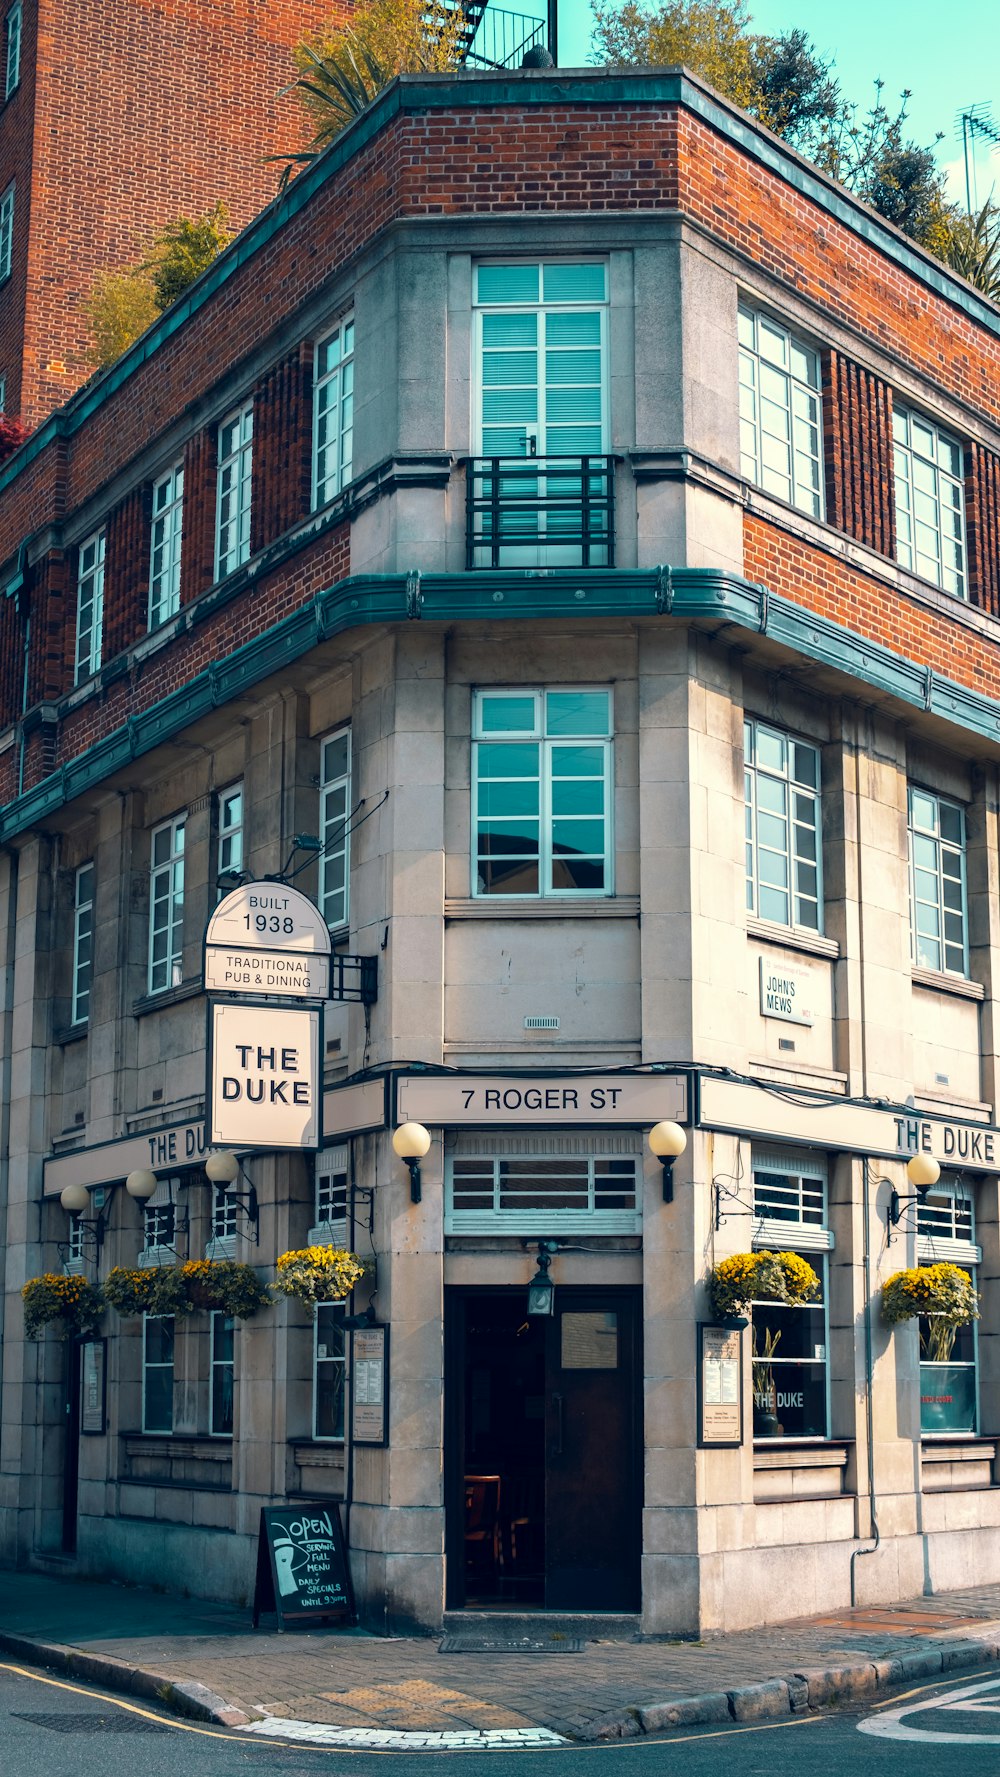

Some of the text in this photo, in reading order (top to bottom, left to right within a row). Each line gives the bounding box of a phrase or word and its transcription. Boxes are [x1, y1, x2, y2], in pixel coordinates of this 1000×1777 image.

[249, 896, 290, 910] BUILT
[243, 913, 294, 934] 1938
[226, 956, 310, 973] TRADITIONAL
[225, 972, 311, 988] PUB & DINING
[766, 976, 795, 997] JOHN'S
[766, 993, 792, 1014] MEWS
[235, 1044, 299, 1072] THE
[222, 1077, 311, 1105] DUKE
[461, 1088, 622, 1109] 7 ROGER ST
[148, 1125, 215, 1165] THE DU
[894, 1117, 995, 1162] THE DUKE
[755, 1392, 804, 1408] THE DUKE
[289, 1511, 333, 1540] OPEN
[306, 1543, 336, 1553] SERVING
[312, 1553, 330, 1562] FULL
[307, 1563, 331, 1572] MENU
[298, 1578, 320, 1586] DAILY
[306, 1583, 341, 1595] SPECIALS
[301, 1597, 323, 1606] UNTIL
